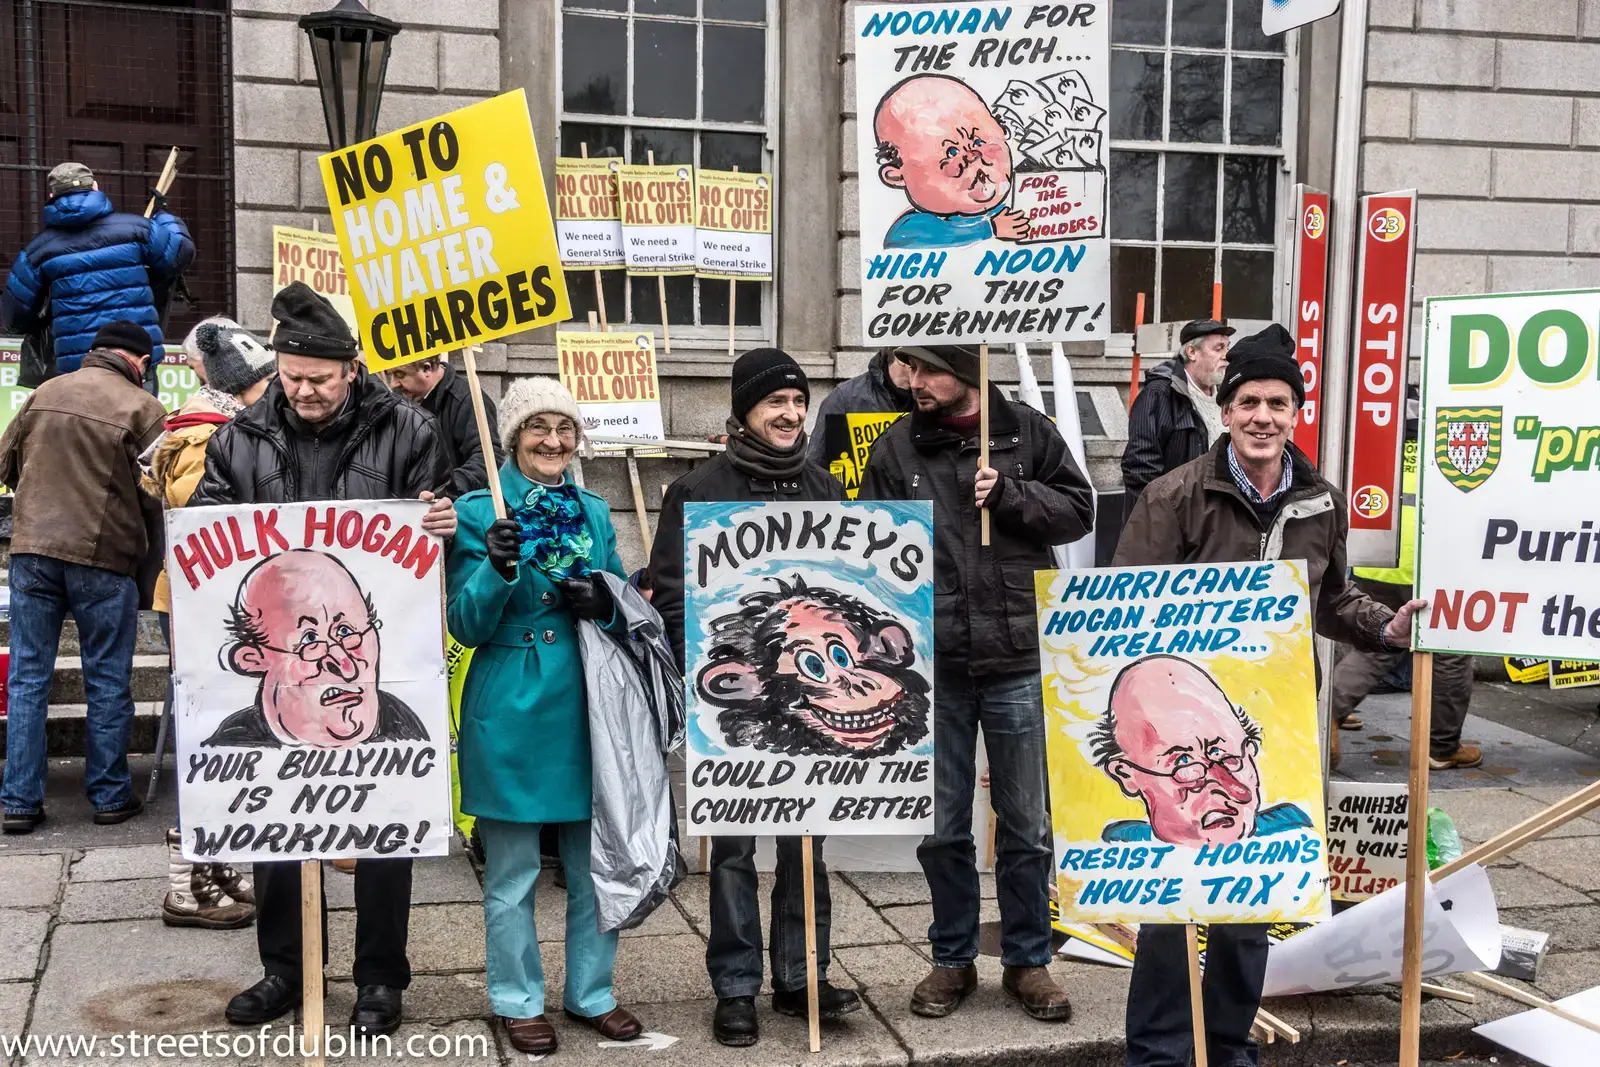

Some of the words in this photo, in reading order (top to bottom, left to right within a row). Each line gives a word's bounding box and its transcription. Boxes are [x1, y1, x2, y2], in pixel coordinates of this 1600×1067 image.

[862, 6, 1012, 37] NOONAN
[1024, 3, 1096, 29] FOR
[894, 41, 958, 72] THE
[331, 144, 392, 206] NO
[402, 122, 459, 181] TO
[556, 174, 576, 196] NO
[580, 174, 618, 196] CUTS
[623, 181, 644, 202] NO
[647, 181, 691, 202] CUTS!
[1018, 174, 1059, 192] FOR
[1036, 186, 1067, 202] THE
[560, 196, 586, 218] ALL
[700, 185, 721, 206] NO
[725, 188, 768, 210] CUTS!
[343, 174, 470, 260] HOME
[484, 162, 522, 214] &
[625, 202, 652, 224] ALL
[656, 202, 692, 224] OUT!
[700, 206, 727, 228] ALL
[731, 209, 768, 230] OUT!
[1029, 202, 1082, 220] BOND-
[1307, 213, 1321, 230] 23
[582, 232, 603, 240] need
[1029, 216, 1098, 240] HOLDERS
[1375, 216, 1399, 234] 23
[278, 242, 302, 266] NO
[567, 249, 601, 257] General
[633, 254, 666, 262] General
[668, 254, 695, 262] Strike
[703, 241, 718, 250] We
[354, 226, 500, 310] WATER
[703, 257, 738, 267] General
[741, 260, 767, 269] Strike
[866, 251, 948, 280] HIGH
[974, 244, 1086, 277] NOON
[314, 270, 350, 295] OUT
[878, 284, 952, 308] FOR
[984, 278, 1064, 305] THIS
[371, 265, 556, 361] CHARGES
[868, 302, 1106, 340] GOVERNMENT!
[1448, 309, 1600, 389] DO
[572, 351, 598, 376] NO
[602, 350, 653, 375] CUTS!
[1300, 301, 1319, 425] STOP
[1362, 302, 1397, 427] STOP
[576, 376, 608, 400] ALL
[612, 376, 655, 400] OUT!
[604, 416, 629, 425] need
[1358, 493, 1382, 511] 23
[173, 508, 290, 591] HULK
[303, 507, 440, 580] HOGAN
[698, 510, 924, 588] MONKEYS
[1060, 563, 1275, 603] HURRICANE
[1044, 606, 1147, 637] HOGAN
[1154, 594, 1299, 629] BATTERS
[1429, 589, 1529, 634] NOT
[1542, 595, 1600, 639] the
[186, 750, 263, 784] YOUR
[277, 746, 436, 781] BULLYING
[692, 759, 796, 789] COULD
[804, 760, 871, 786] RUN
[878, 760, 930, 784] THE
[228, 785, 274, 815] IS
[290, 783, 377, 815] NOT
[691, 796, 816, 825] COUNTRY
[828, 796, 934, 822] BETTER
[1339, 794, 1408, 814] BEHIND
[1327, 815, 1358, 834] WE
[194, 820, 431, 856] WORKING!
[1060, 845, 1176, 871] RESIST
[1194, 834, 1320, 866] HOGAN'S
[1078, 876, 1183, 906] HOUSE
